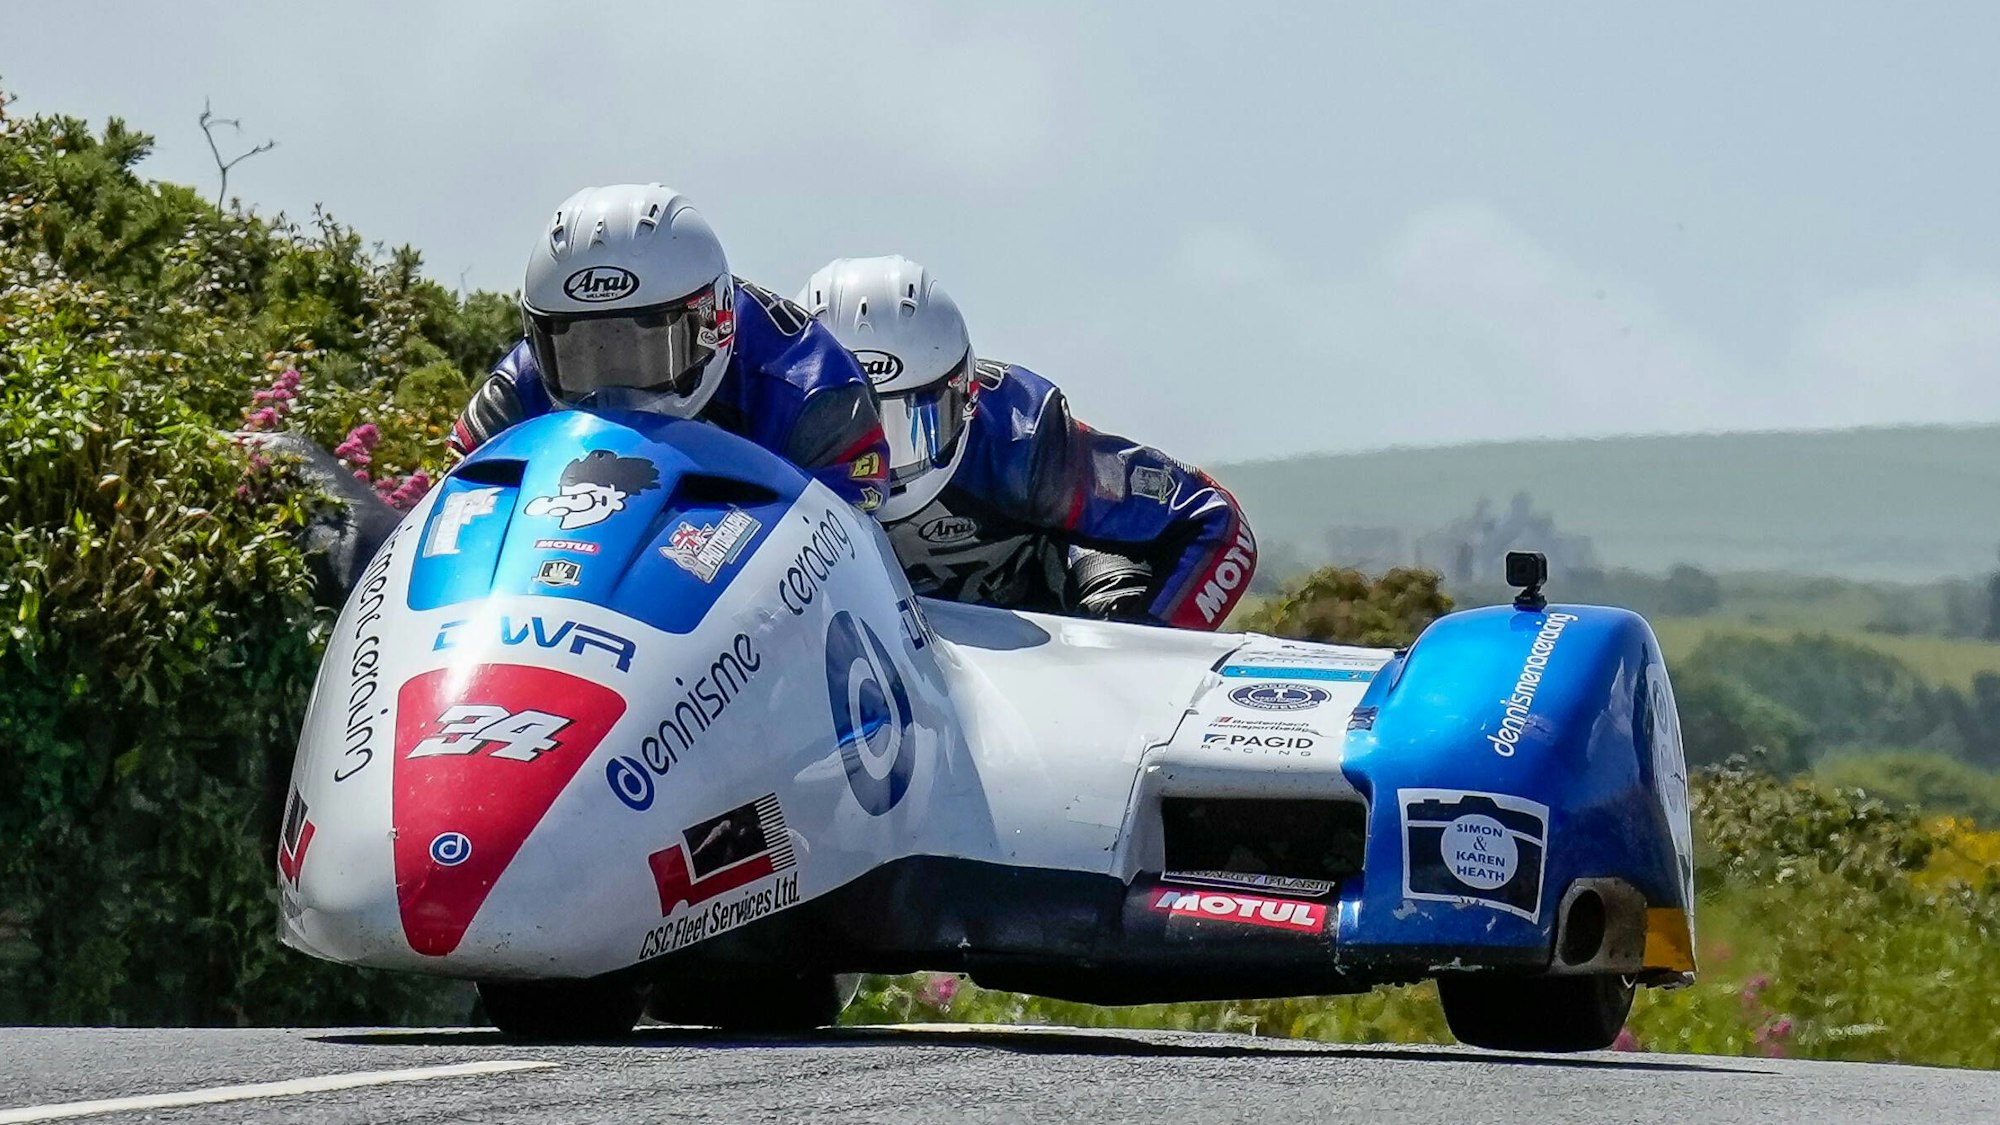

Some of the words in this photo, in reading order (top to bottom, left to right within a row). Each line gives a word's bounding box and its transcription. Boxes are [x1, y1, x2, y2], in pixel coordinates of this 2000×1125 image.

[569, 270, 632, 292] Arai
[927, 519, 973, 537] Arai
[536, 540, 596, 553] MOTUL
[778, 508, 856, 616] ceracing
[1195, 512, 1255, 624] MOTU
[1487, 612, 1579, 758] dennismenaceracing
[1200, 744, 1312, 757] RACING
[1230, 735, 1314, 749] PAGID
[1456, 823, 1503, 838] SIMON
[1473, 836, 1488, 852] &
[1456, 850, 1505, 867] KAREN
[1456, 865, 1505, 882] HEATH
[638, 922, 674, 960] CSC
[671, 908, 709, 950] Fleet
[709, 889, 772, 935] Services
[774, 871, 801, 910] Ltd.
[1155, 891, 1316, 926] MOTUL
